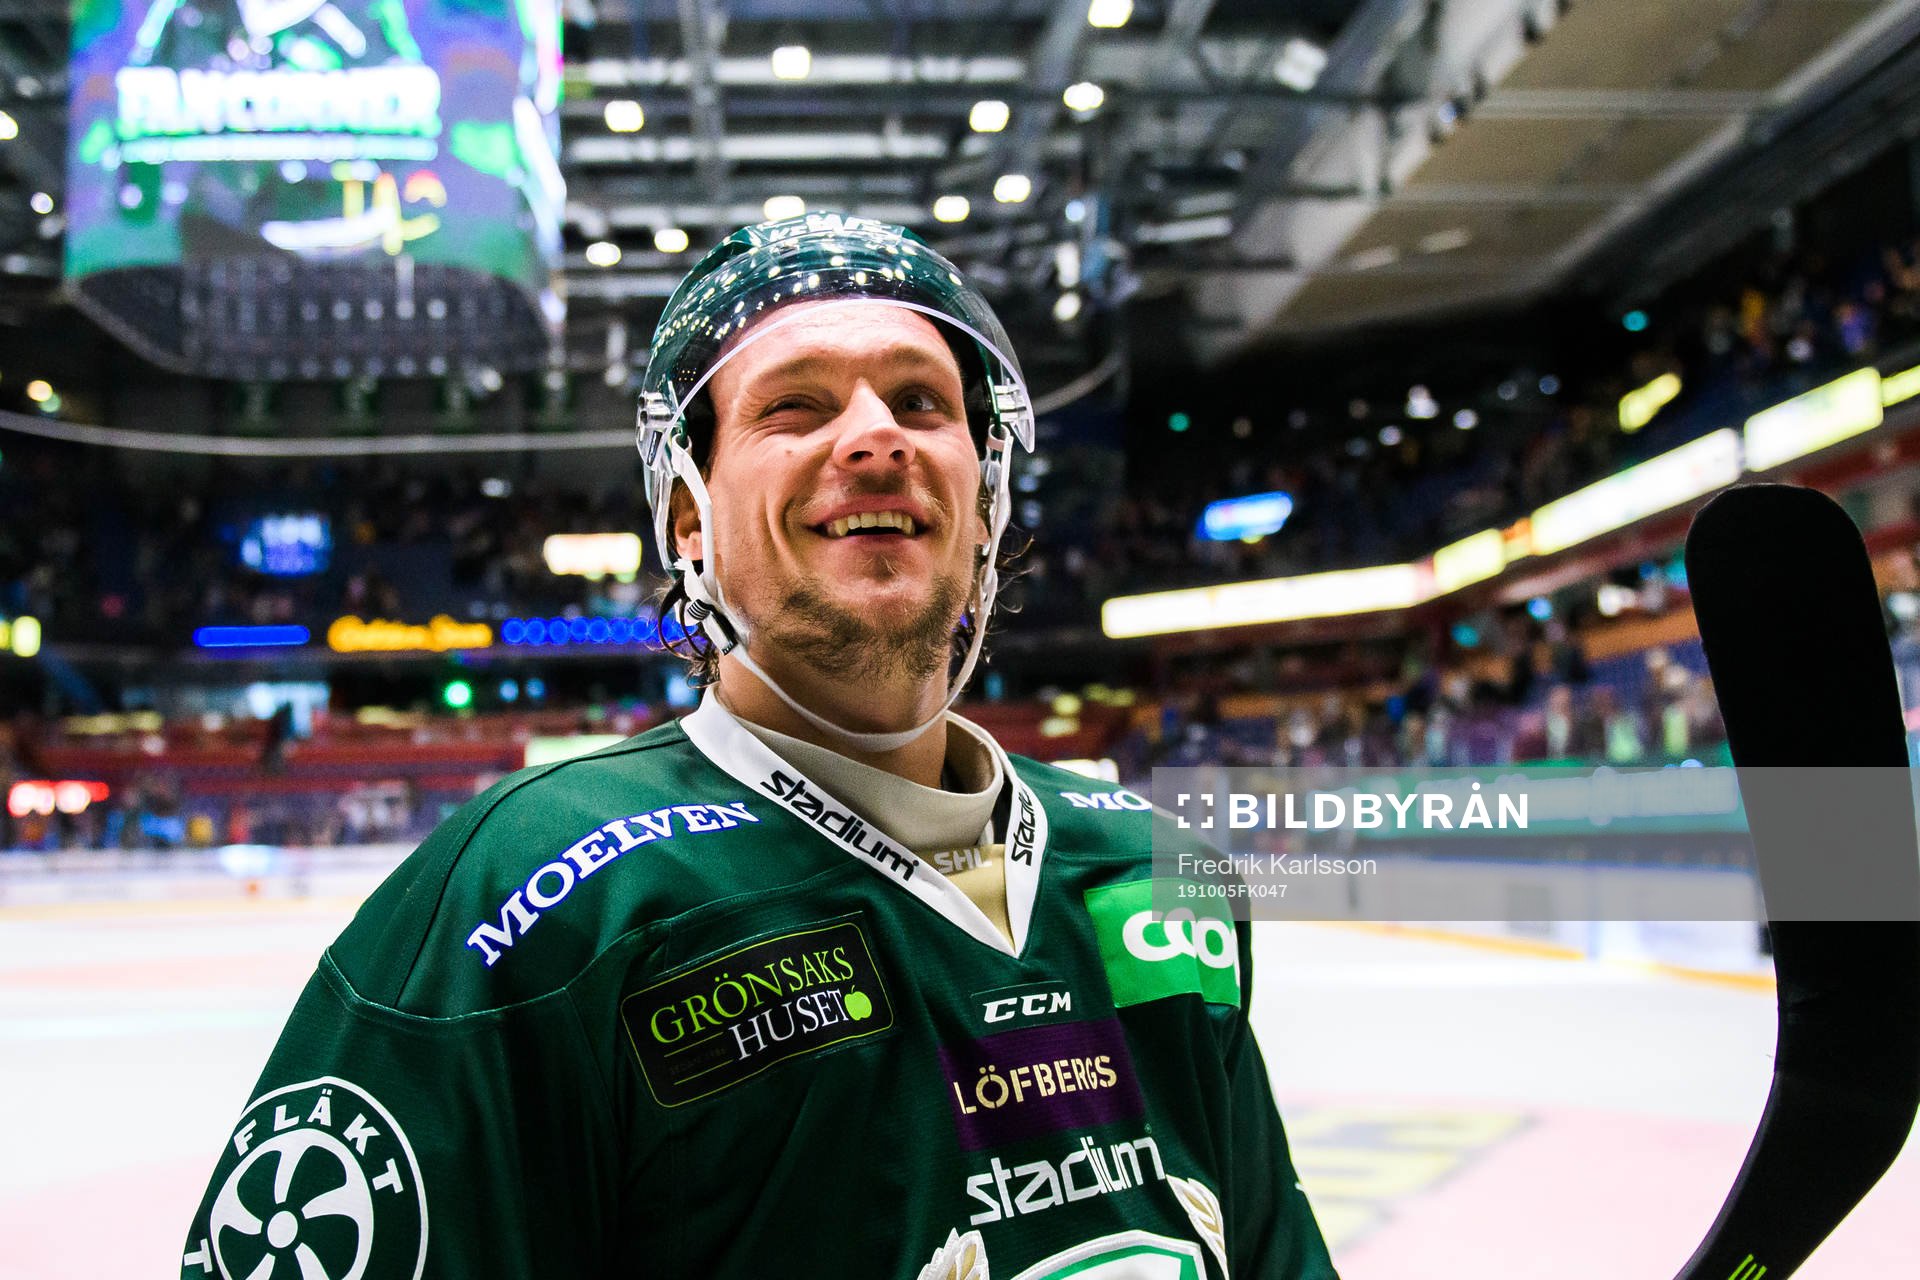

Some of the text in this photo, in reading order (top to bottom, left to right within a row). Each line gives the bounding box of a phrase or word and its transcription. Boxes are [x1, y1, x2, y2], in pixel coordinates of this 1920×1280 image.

[761, 770, 920, 881] stadium
[1060, 790, 1152, 811] MO
[466, 801, 760, 968] MOELVEN
[934, 847, 992, 874] SHL
[650, 946, 855, 1045] GRÖNSAKS
[731, 989, 850, 1062] HUSET
[982, 991, 1072, 1024] CCM
[953, 1055, 1118, 1116] LÖFBERGS
[233, 1088, 404, 1194] FLÄKT
[966, 1136, 1166, 1226] stadium
